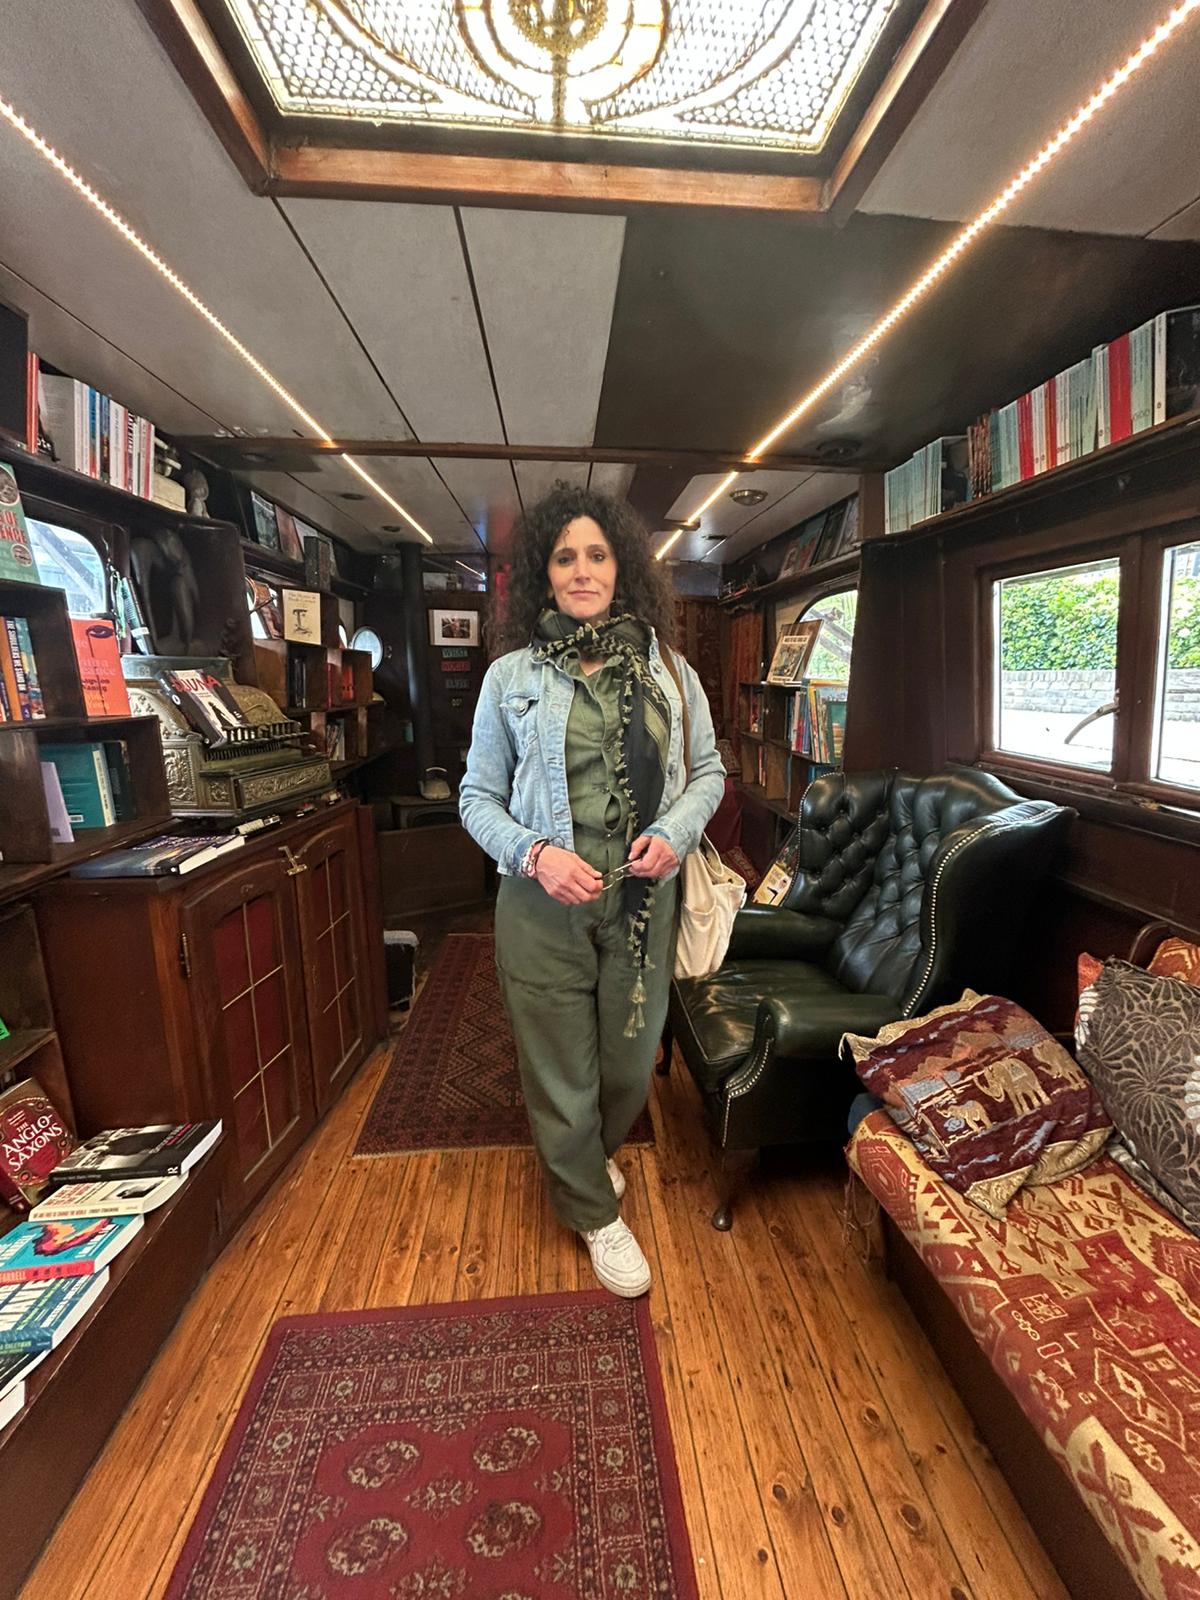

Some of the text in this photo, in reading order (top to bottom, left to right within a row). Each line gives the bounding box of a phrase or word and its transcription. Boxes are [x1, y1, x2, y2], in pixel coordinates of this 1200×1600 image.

[2, 1114, 53, 1158] ANGLO-
[8, 1122, 63, 1172] SAXONS
[16, 1121, 29, 1133] THE
